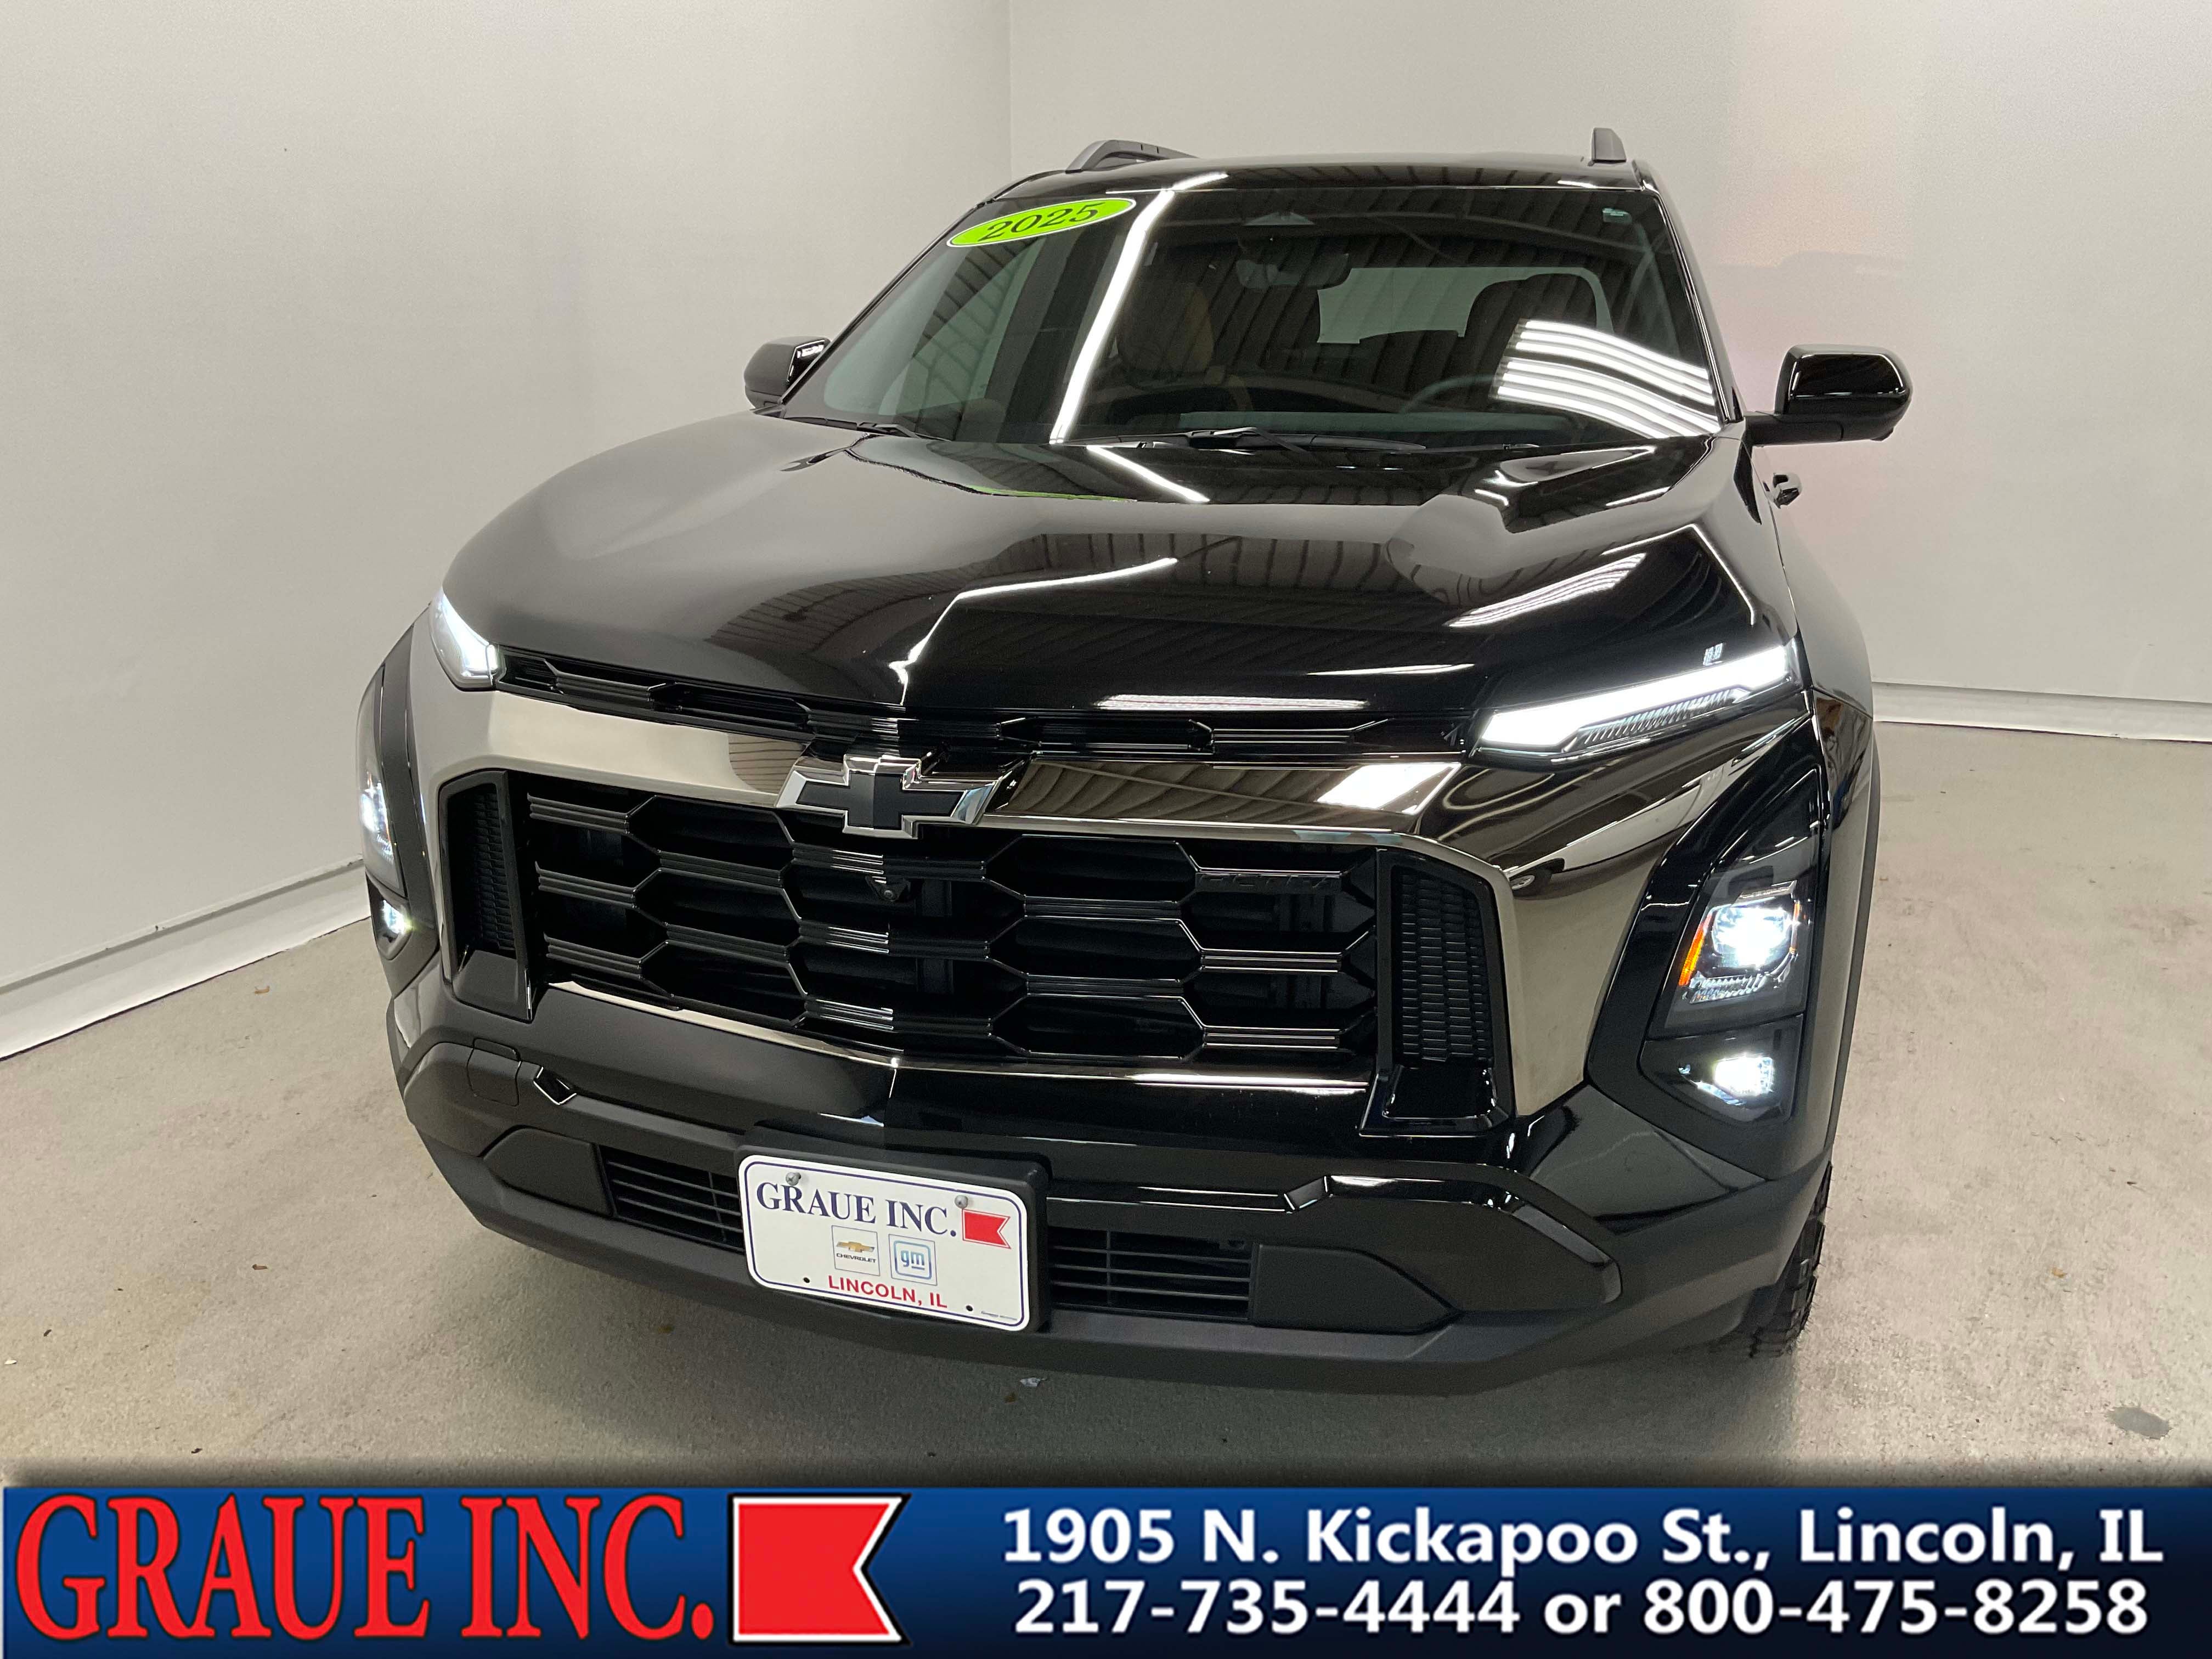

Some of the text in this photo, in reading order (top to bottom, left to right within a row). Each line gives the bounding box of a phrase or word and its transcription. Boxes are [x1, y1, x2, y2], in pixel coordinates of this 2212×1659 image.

[978, 202, 1105, 242] 2025
[757, 1182, 957, 1237] GRAUE INC.
[836, 1252, 877, 1263] CHEVROLET
[901, 1250, 925, 1271] gm
[828, 1275, 947, 1308] LINCOLN, IL
